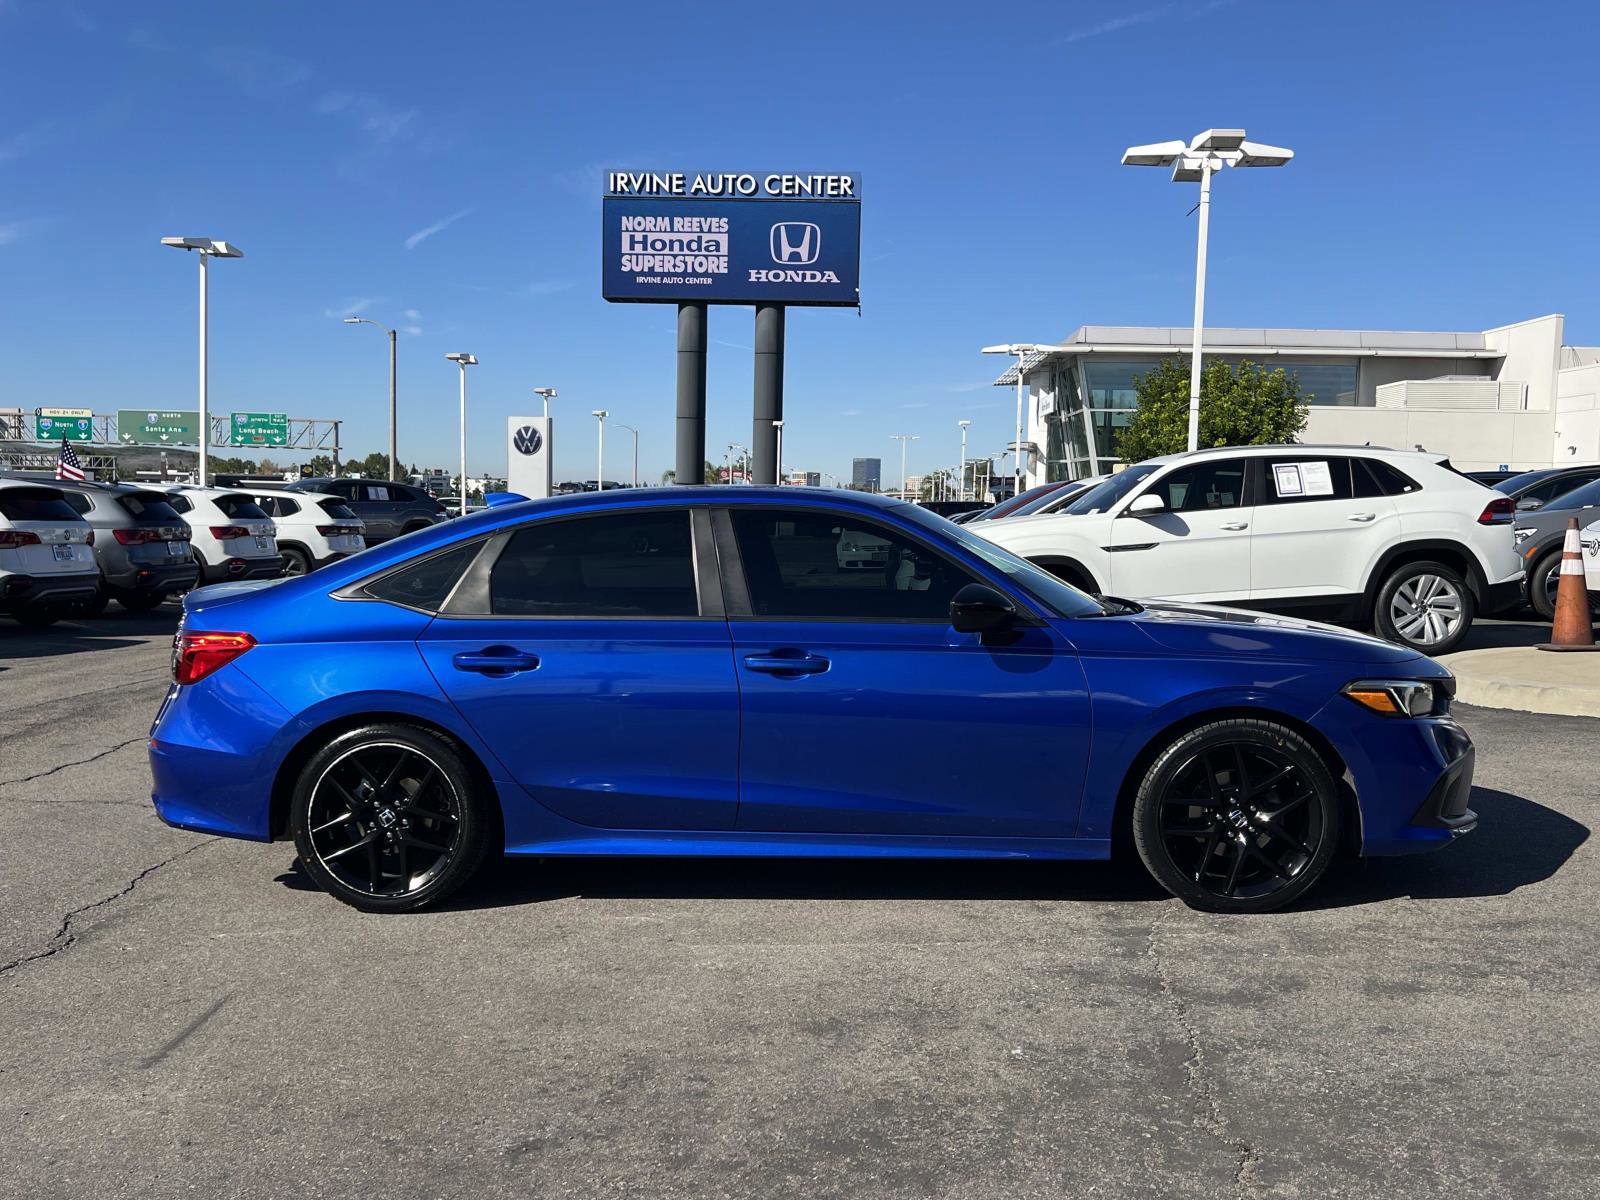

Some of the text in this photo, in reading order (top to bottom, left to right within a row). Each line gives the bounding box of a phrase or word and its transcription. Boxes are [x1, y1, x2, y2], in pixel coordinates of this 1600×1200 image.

[609, 172, 853, 195] IRVINE AUTO CENTER
[621, 215, 729, 233] NORM REEVES
[629, 234, 721, 253] Honda
[621, 254, 729, 273] SUPERSTORE
[636, 276, 713, 285] IRVINE AUTO CENTER
[748, 269, 841, 283] HONDA
